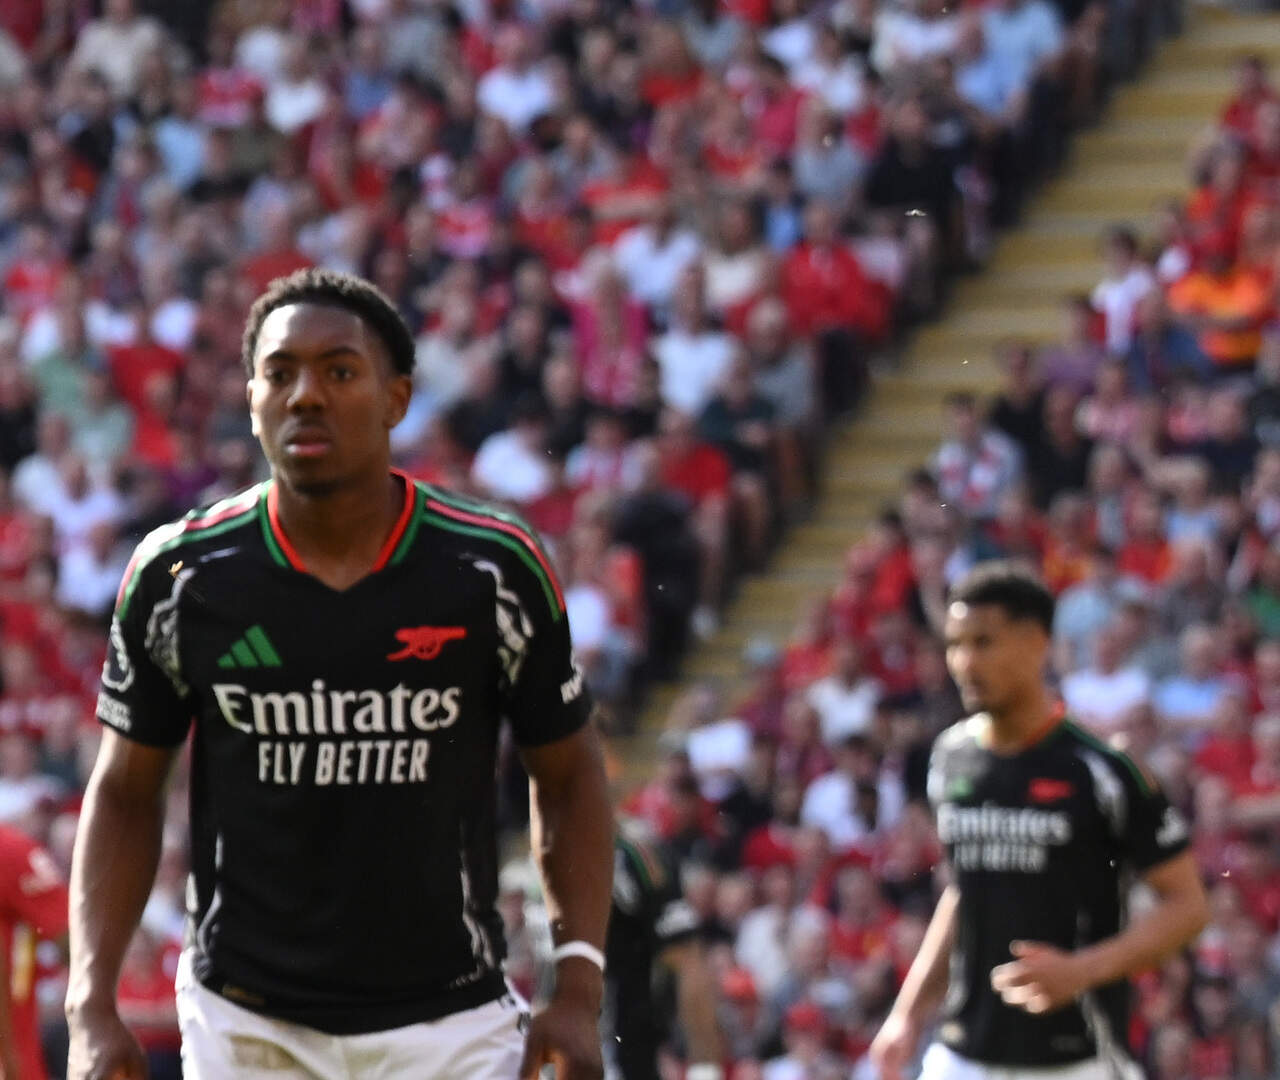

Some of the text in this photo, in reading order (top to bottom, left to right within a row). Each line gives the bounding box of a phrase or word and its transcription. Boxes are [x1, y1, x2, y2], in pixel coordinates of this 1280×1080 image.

[212, 679, 462, 735] Emirates
[258, 738, 430, 785] FLY BETTER
